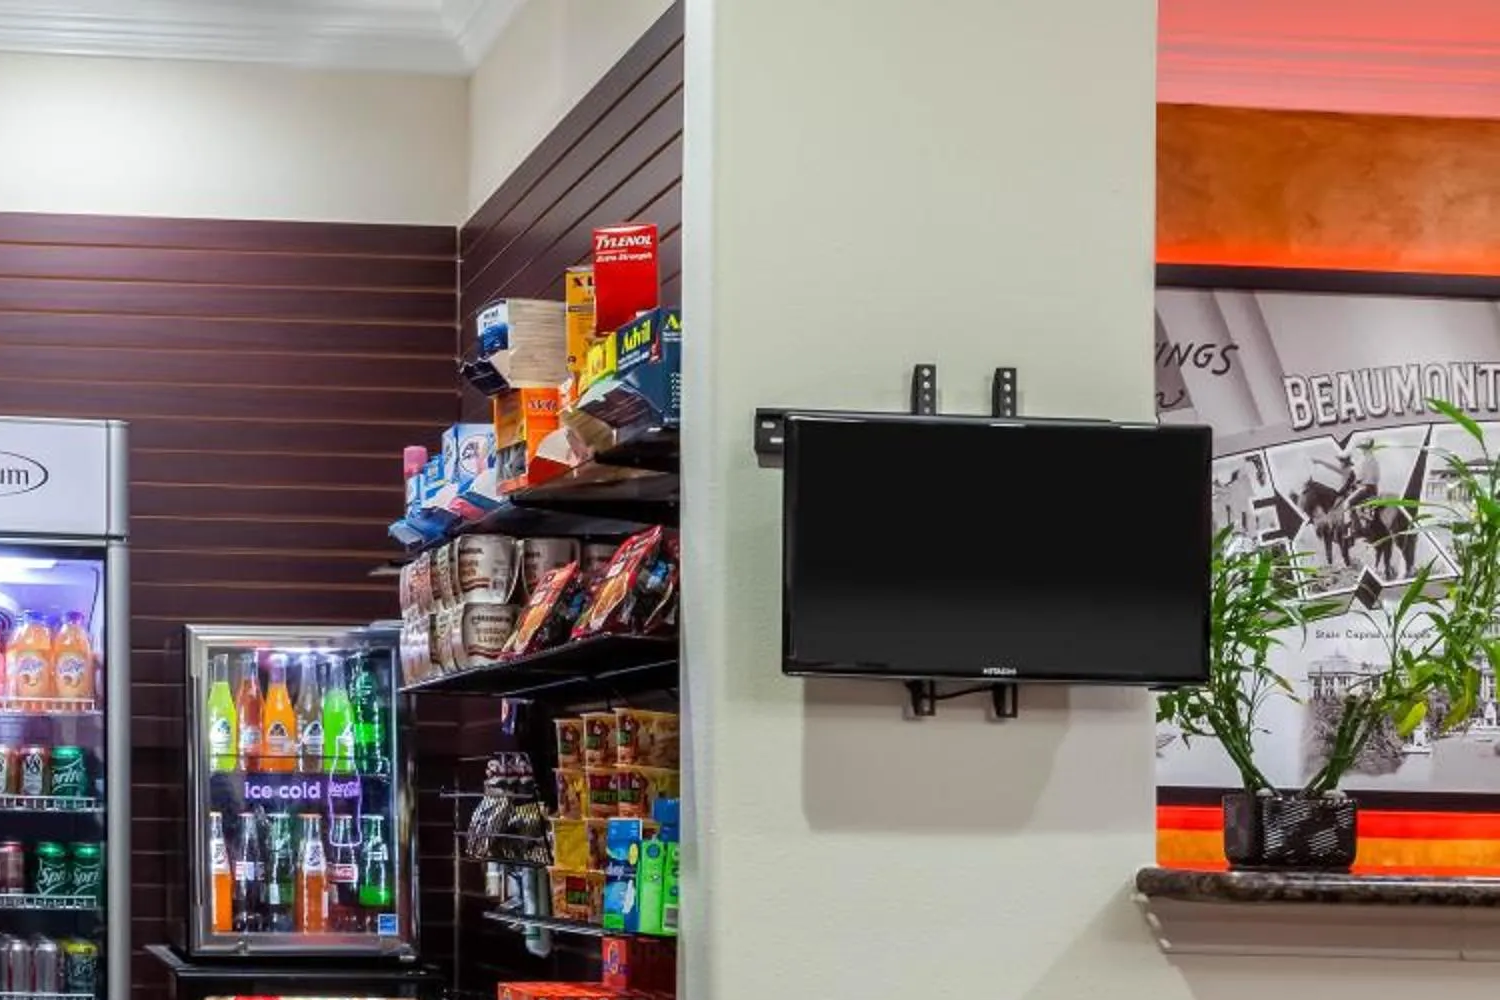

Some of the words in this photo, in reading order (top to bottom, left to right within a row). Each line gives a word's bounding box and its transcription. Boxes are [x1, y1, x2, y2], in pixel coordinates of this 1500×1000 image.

[595, 235, 652, 250] TYLENOL
[1155, 342, 1239, 376] INGS
[1284, 362, 1500, 431] BEAUMONT
[279, 782, 321, 799] cold
